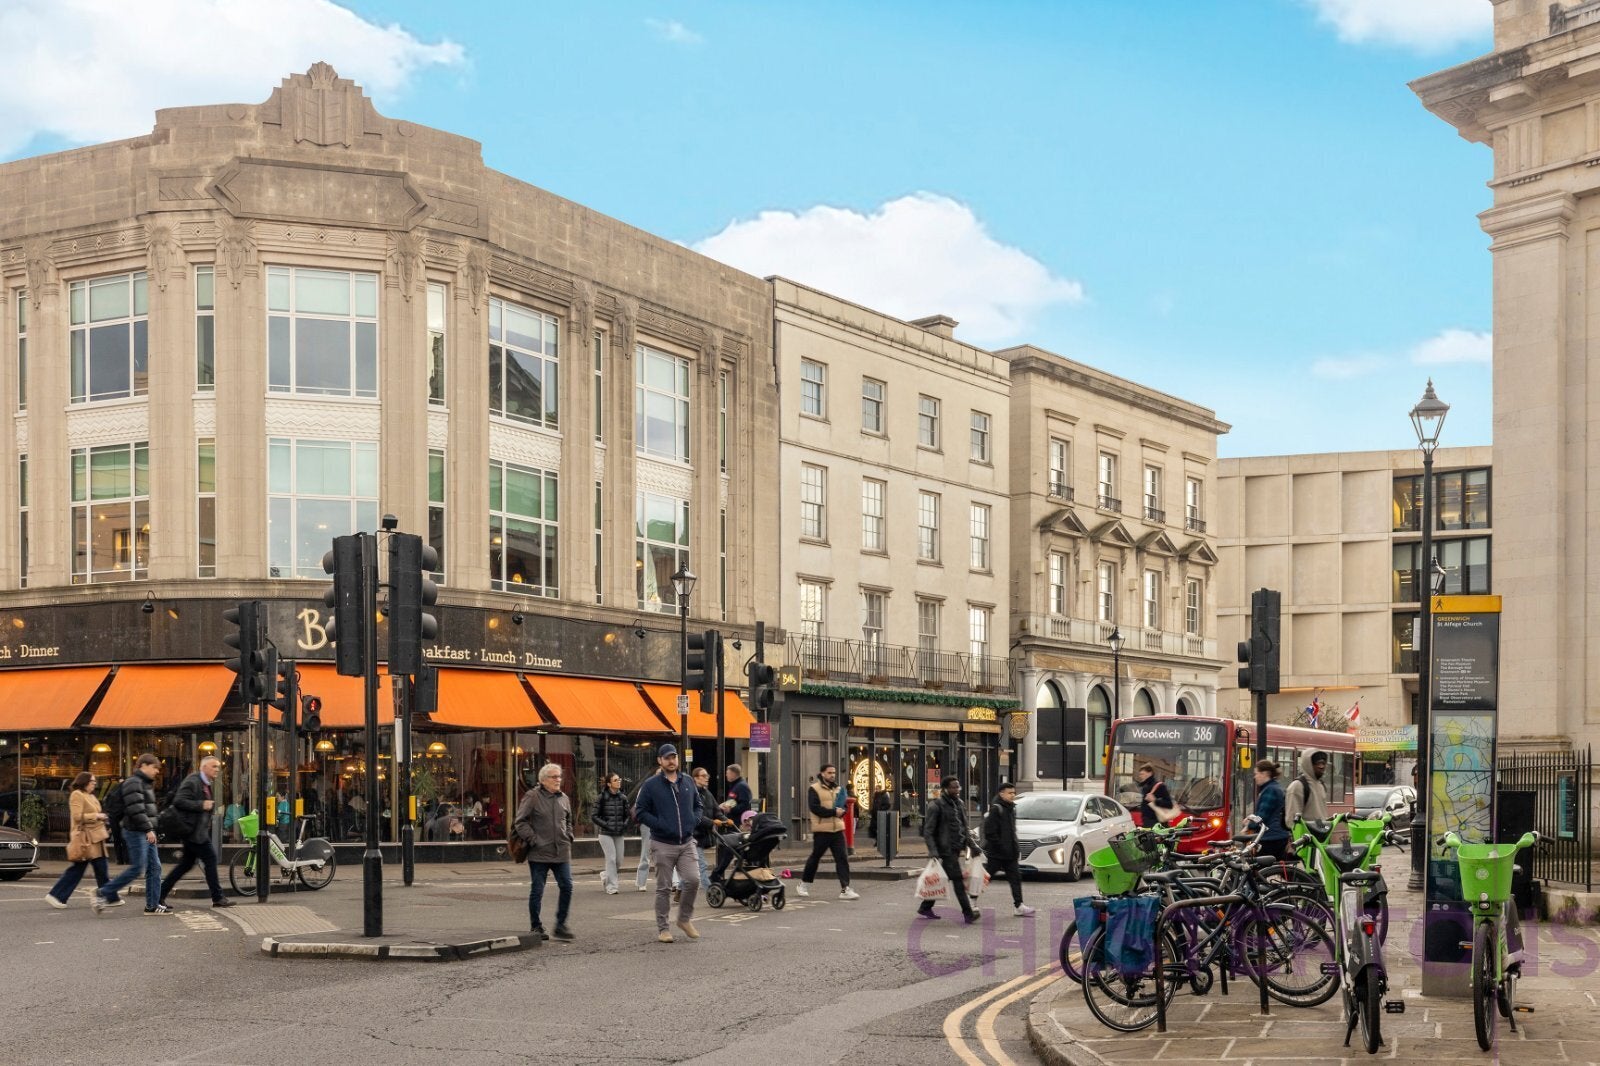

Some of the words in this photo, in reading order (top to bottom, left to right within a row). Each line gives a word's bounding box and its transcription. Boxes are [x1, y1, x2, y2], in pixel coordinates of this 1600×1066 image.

[20, 644, 60, 658] Dinner
[422, 645, 471, 660] akfast
[481, 648, 517, 664] Lunch
[525, 652, 563, 668] Dinner
[1132, 729, 1181, 739] Woolwich
[1193, 726, 1212, 741] 386
[1359, 728, 1408, 736] Greenwich
